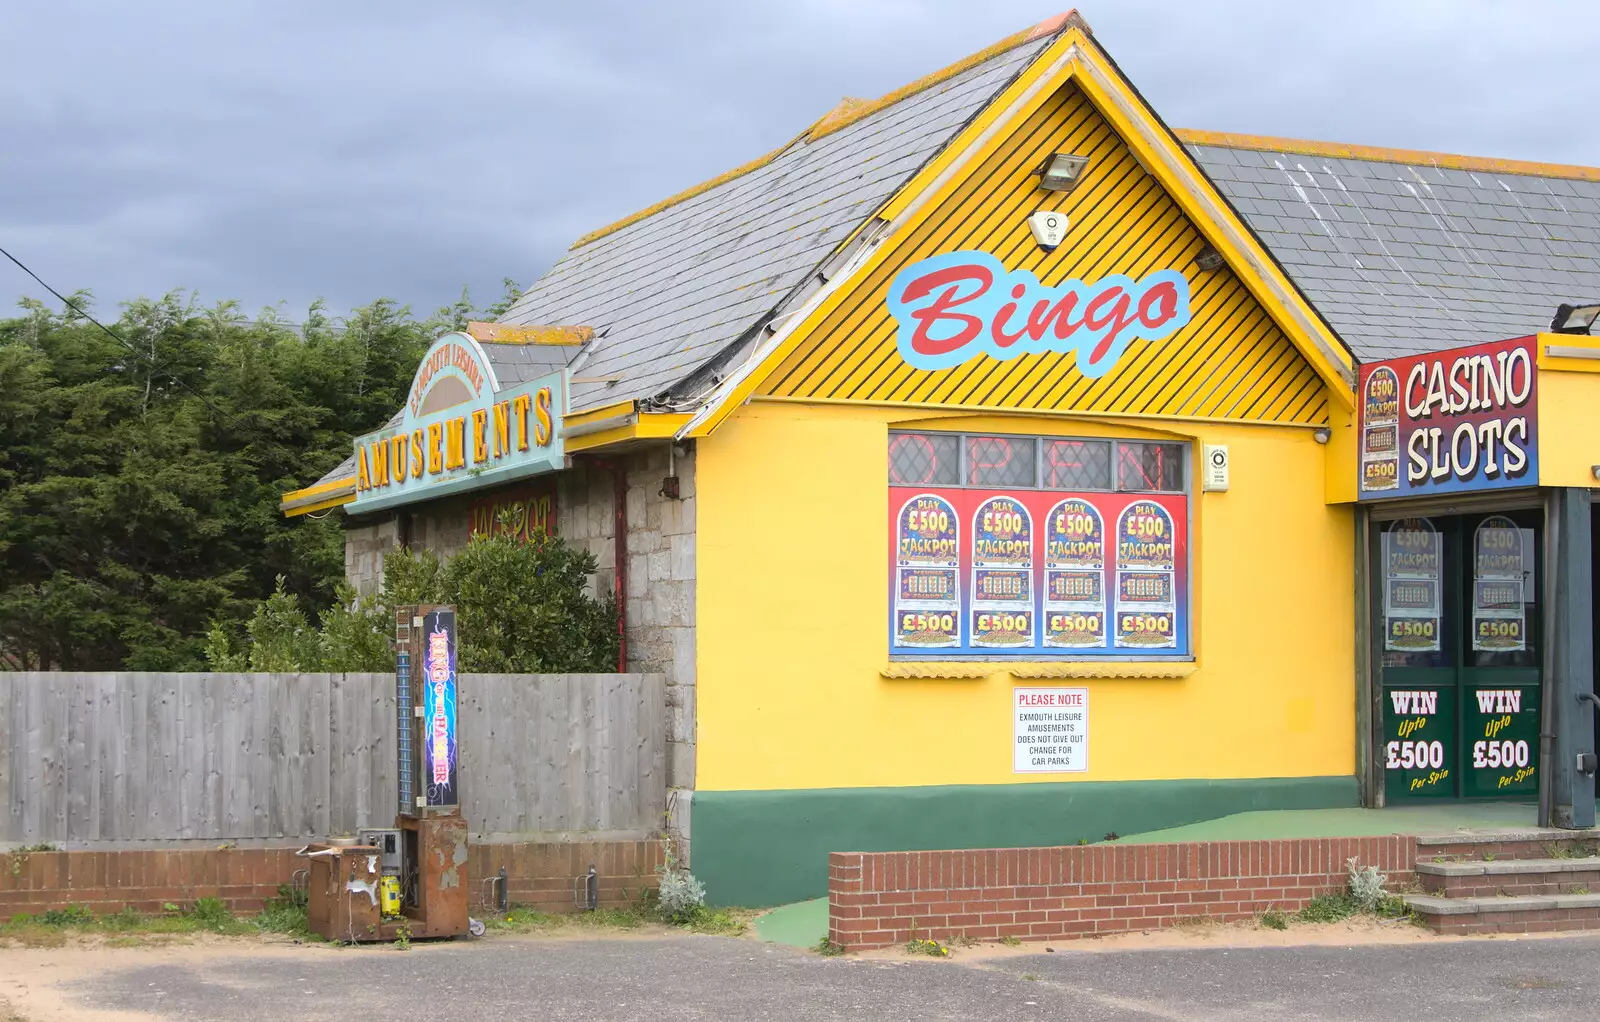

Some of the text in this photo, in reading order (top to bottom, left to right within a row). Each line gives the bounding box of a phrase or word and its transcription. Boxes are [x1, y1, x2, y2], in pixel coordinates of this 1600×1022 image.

[900, 264, 1178, 365] Bingo
[1371, 379, 1393, 397] £500
[1405, 347, 1532, 418] CASINO
[357, 386, 553, 491] AMUSEMENTS
[1407, 417, 1526, 482] SLOTS
[1367, 462, 1395, 478] £500
[917, 499, 940, 510] PLAY
[992, 501, 1013, 512] PLAY
[1064, 503, 1086, 513] PLAY
[1135, 505, 1156, 515] PLAY
[908, 510, 948, 533] £500
[983, 512, 1022, 534] £500
[1056, 514, 1093, 536] £500
[1127, 515, 1163, 537] £500
[901, 538, 956, 554] JACKPOT
[1396, 528, 1429, 548] £500
[1482, 530, 1513, 548] £500
[976, 539, 1029, 555] JACKPOT
[1049, 541, 1101, 556] JACKPOT
[1120, 542, 1170, 557] JACKPOT
[1391, 553, 1436, 568] JACKPOT
[1478, 554, 1521, 569] JACKPOT
[903, 614, 953, 631] £500
[978, 615, 1027, 632] £500
[1051, 615, 1099, 632] £500
[1122, 615, 1169, 632] £500
[1392, 621, 1434, 636] £500
[1479, 621, 1519, 636] £500
[431, 634, 448, 681] KING
[1019, 694, 1082, 705] PLEASE NOTE
[1390, 691, 1437, 714] WIN
[1476, 690, 1521, 714] WIN
[1019, 713, 1082, 721] EXMOUTH LEISURE
[1027, 724, 1075, 732] AMUSEMENTS
[1017, 735, 1084, 743] DOES NOT GIVE OUT
[435, 716, 447, 783] HAER
[1029, 746, 1072, 754] CHANGE FOR
[1386, 740, 1444, 769] £500
[1473, 740, 1529, 768] £500
[1031, 757, 1070, 765] CAR PARKS
[1410, 769, 1449, 791] Per Spin
[1498, 767, 1535, 788] Per Spin
